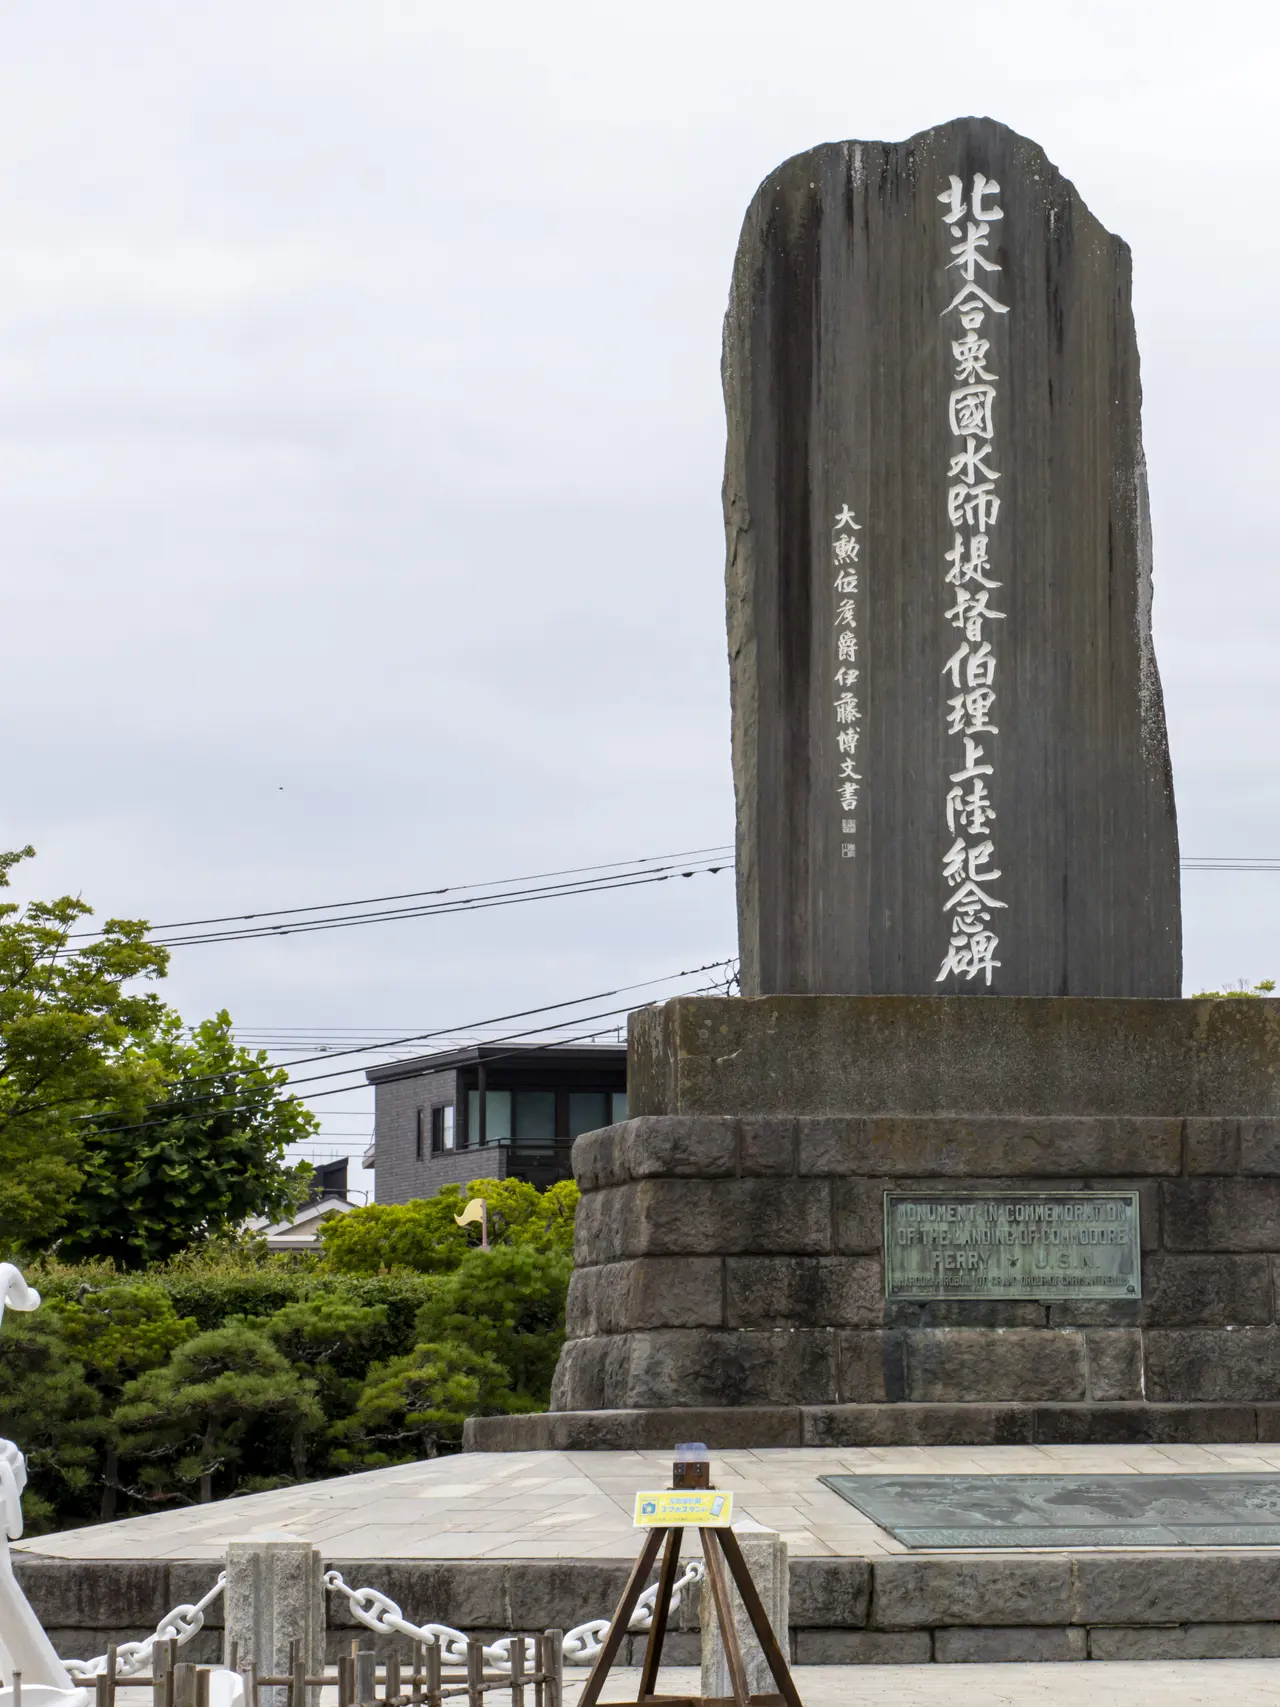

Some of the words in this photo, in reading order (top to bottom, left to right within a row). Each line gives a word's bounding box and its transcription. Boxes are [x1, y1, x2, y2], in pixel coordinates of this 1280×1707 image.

[897, 1203, 977, 1222] MONUMENT
[984, 1203, 999, 1222] IN
[1006, 1203, 1127, 1222] COMMEMORATION
[897, 1227, 915, 1245] OF
[921, 1227, 949, 1245] THE
[953, 1227, 1014, 1245] LANDING
[1018, 1227, 1037, 1245] OF
[1043, 1227, 1128, 1246] COMMODORE
[931, 1250, 992, 1269] PERRY
